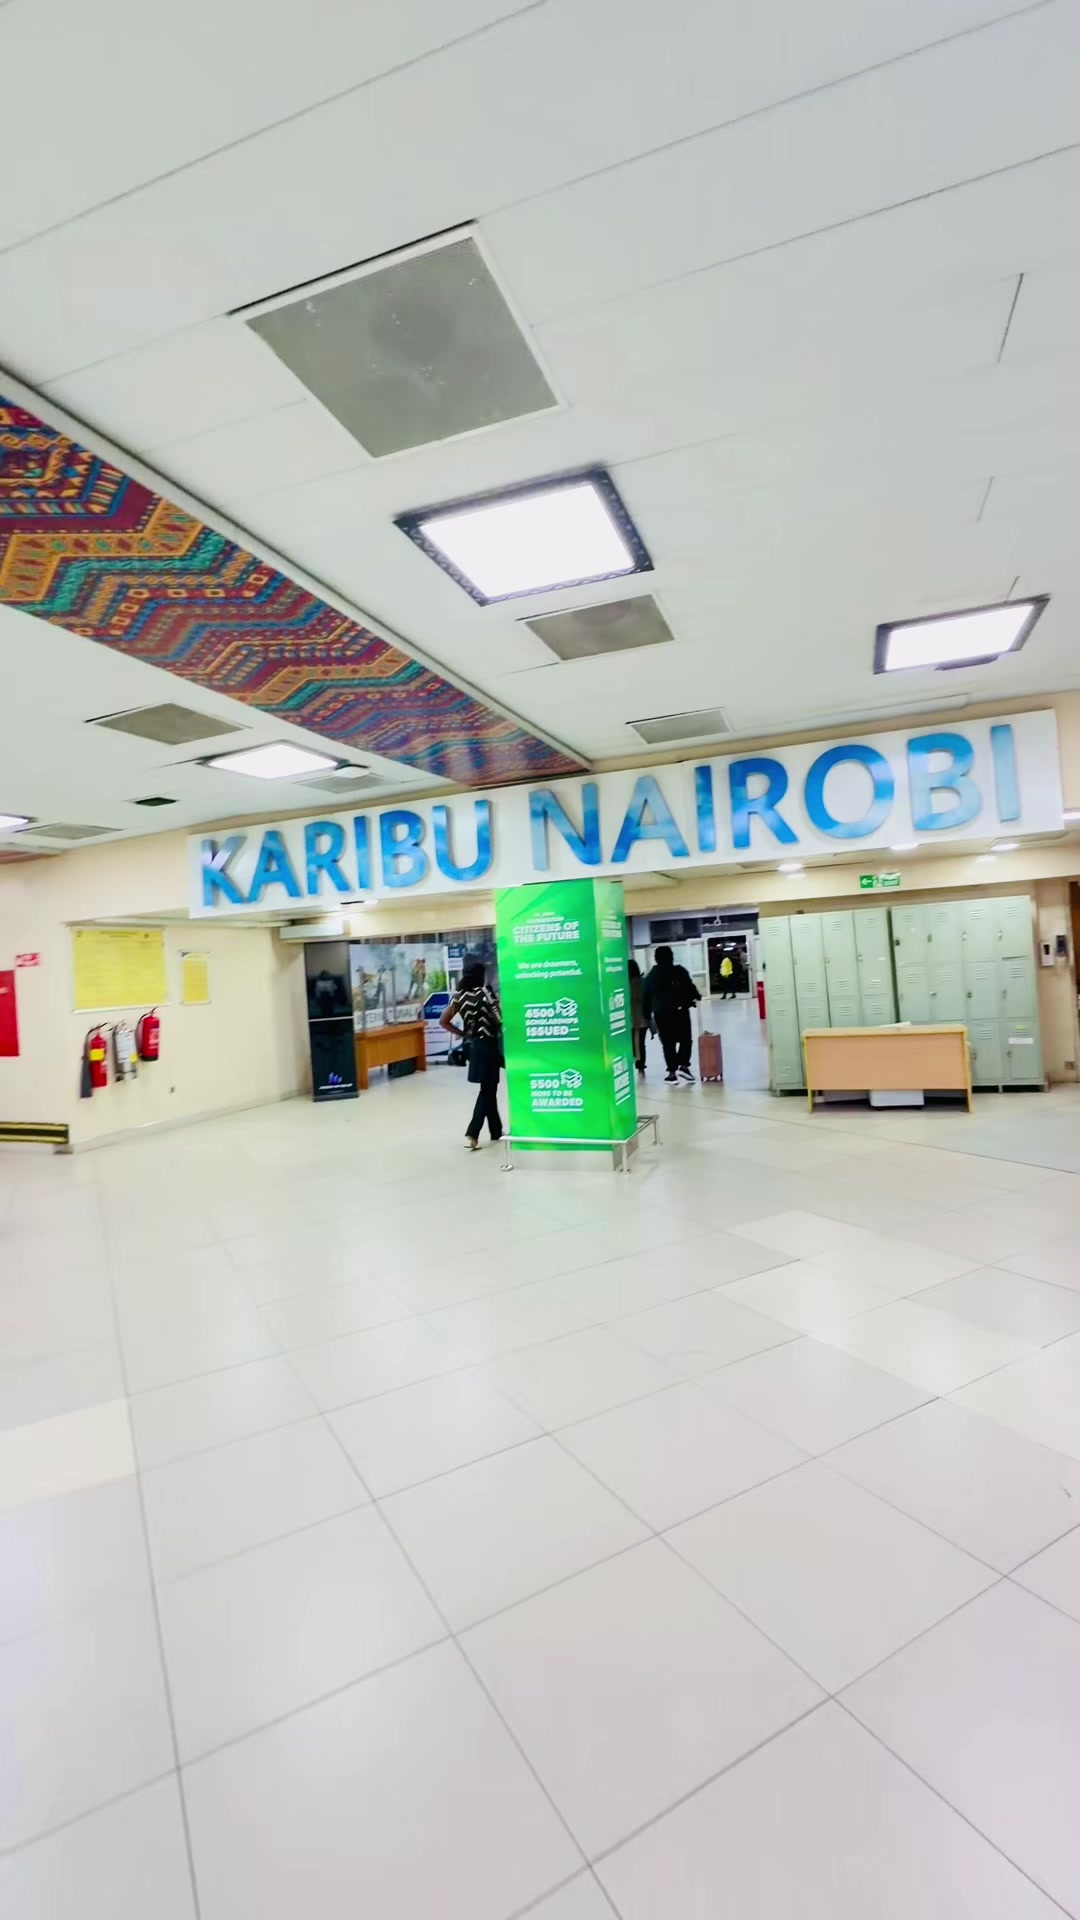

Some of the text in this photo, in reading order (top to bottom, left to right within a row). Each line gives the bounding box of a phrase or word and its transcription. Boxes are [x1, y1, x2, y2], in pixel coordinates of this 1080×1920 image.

[202, 724, 1020, 907] KARIBU NAIROBI
[513, 921, 579, 935] CITIZENS OF
[514, 930, 580, 944] THE FUTURE
[525, 1008, 555, 1018] 4500
[525, 1017, 579, 1026] SCHOLARSHIPS
[526, 1026, 570, 1037] ISSUED
[530, 1079, 560, 1089] 5500
[531, 1097, 583, 1107] AWARDED
